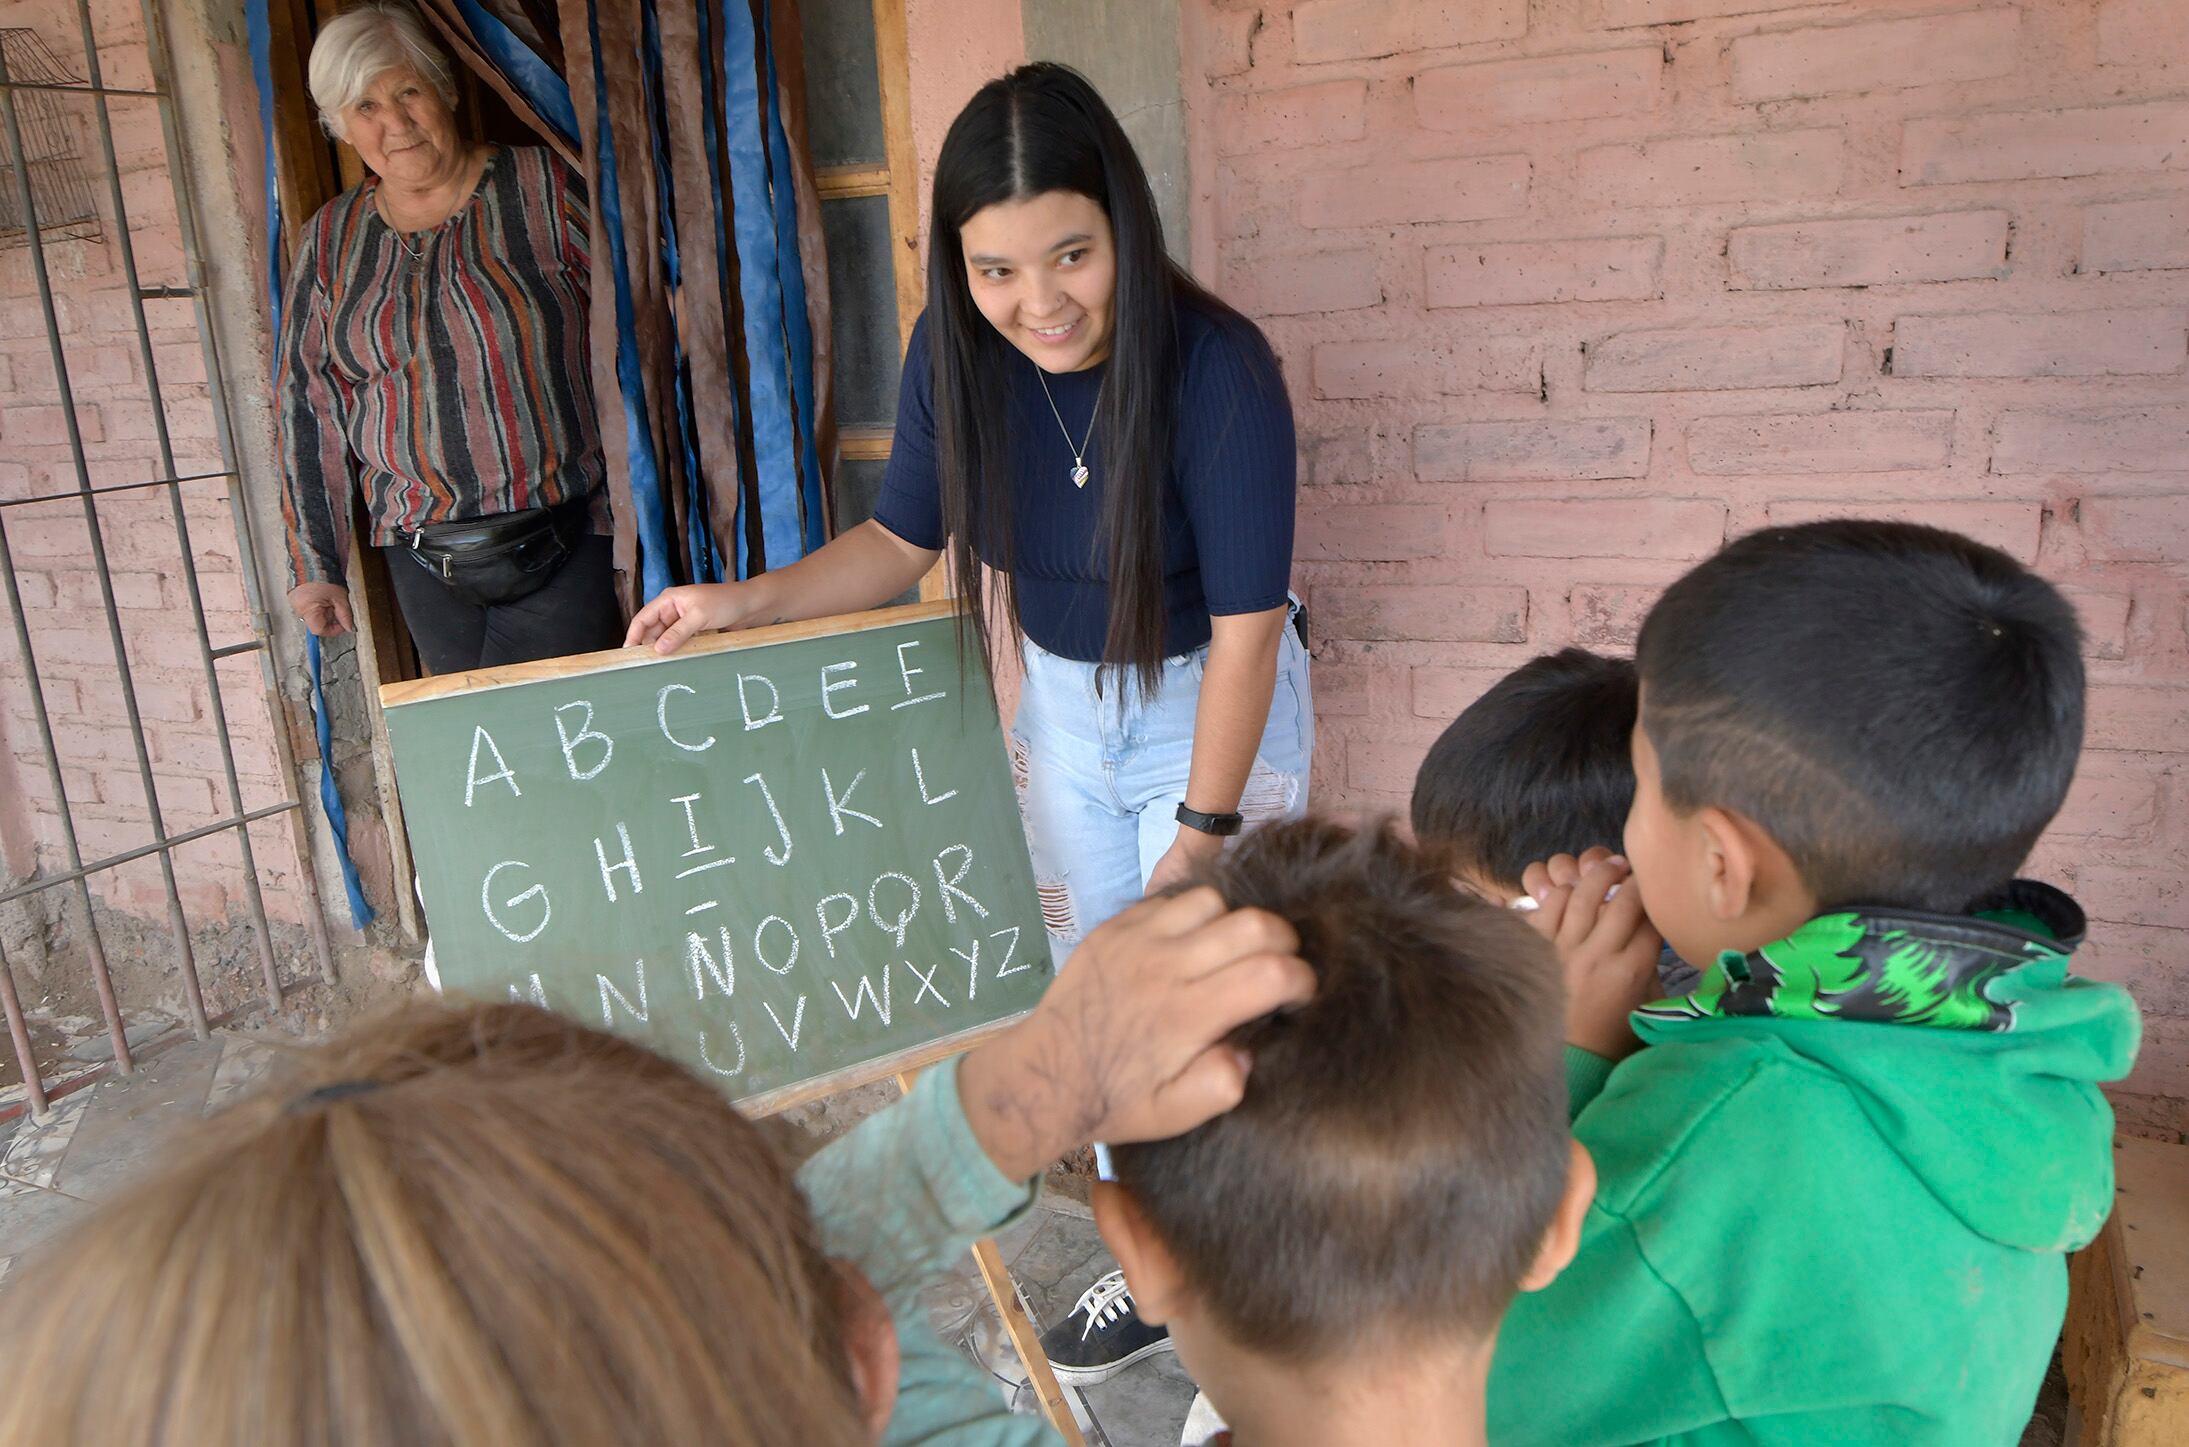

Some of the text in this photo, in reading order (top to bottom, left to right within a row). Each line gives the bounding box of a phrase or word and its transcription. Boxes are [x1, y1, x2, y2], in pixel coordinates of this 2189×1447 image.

[465, 726, 522, 807] A
[554, 700, 613, 780] B
[657, 684, 716, 751] C
[737, 673, 783, 731] D
[821, 661, 870, 719] E
[482, 748, 958, 943] G H I J K L
[596, 958, 648, 1026] N
[754, 914, 799, 976] O
[816, 891, 859, 958] P
[868, 872, 921, 949] Q
[933, 844, 989, 923] R
[699, 926, 1031, 1076] U V W X Y Z
